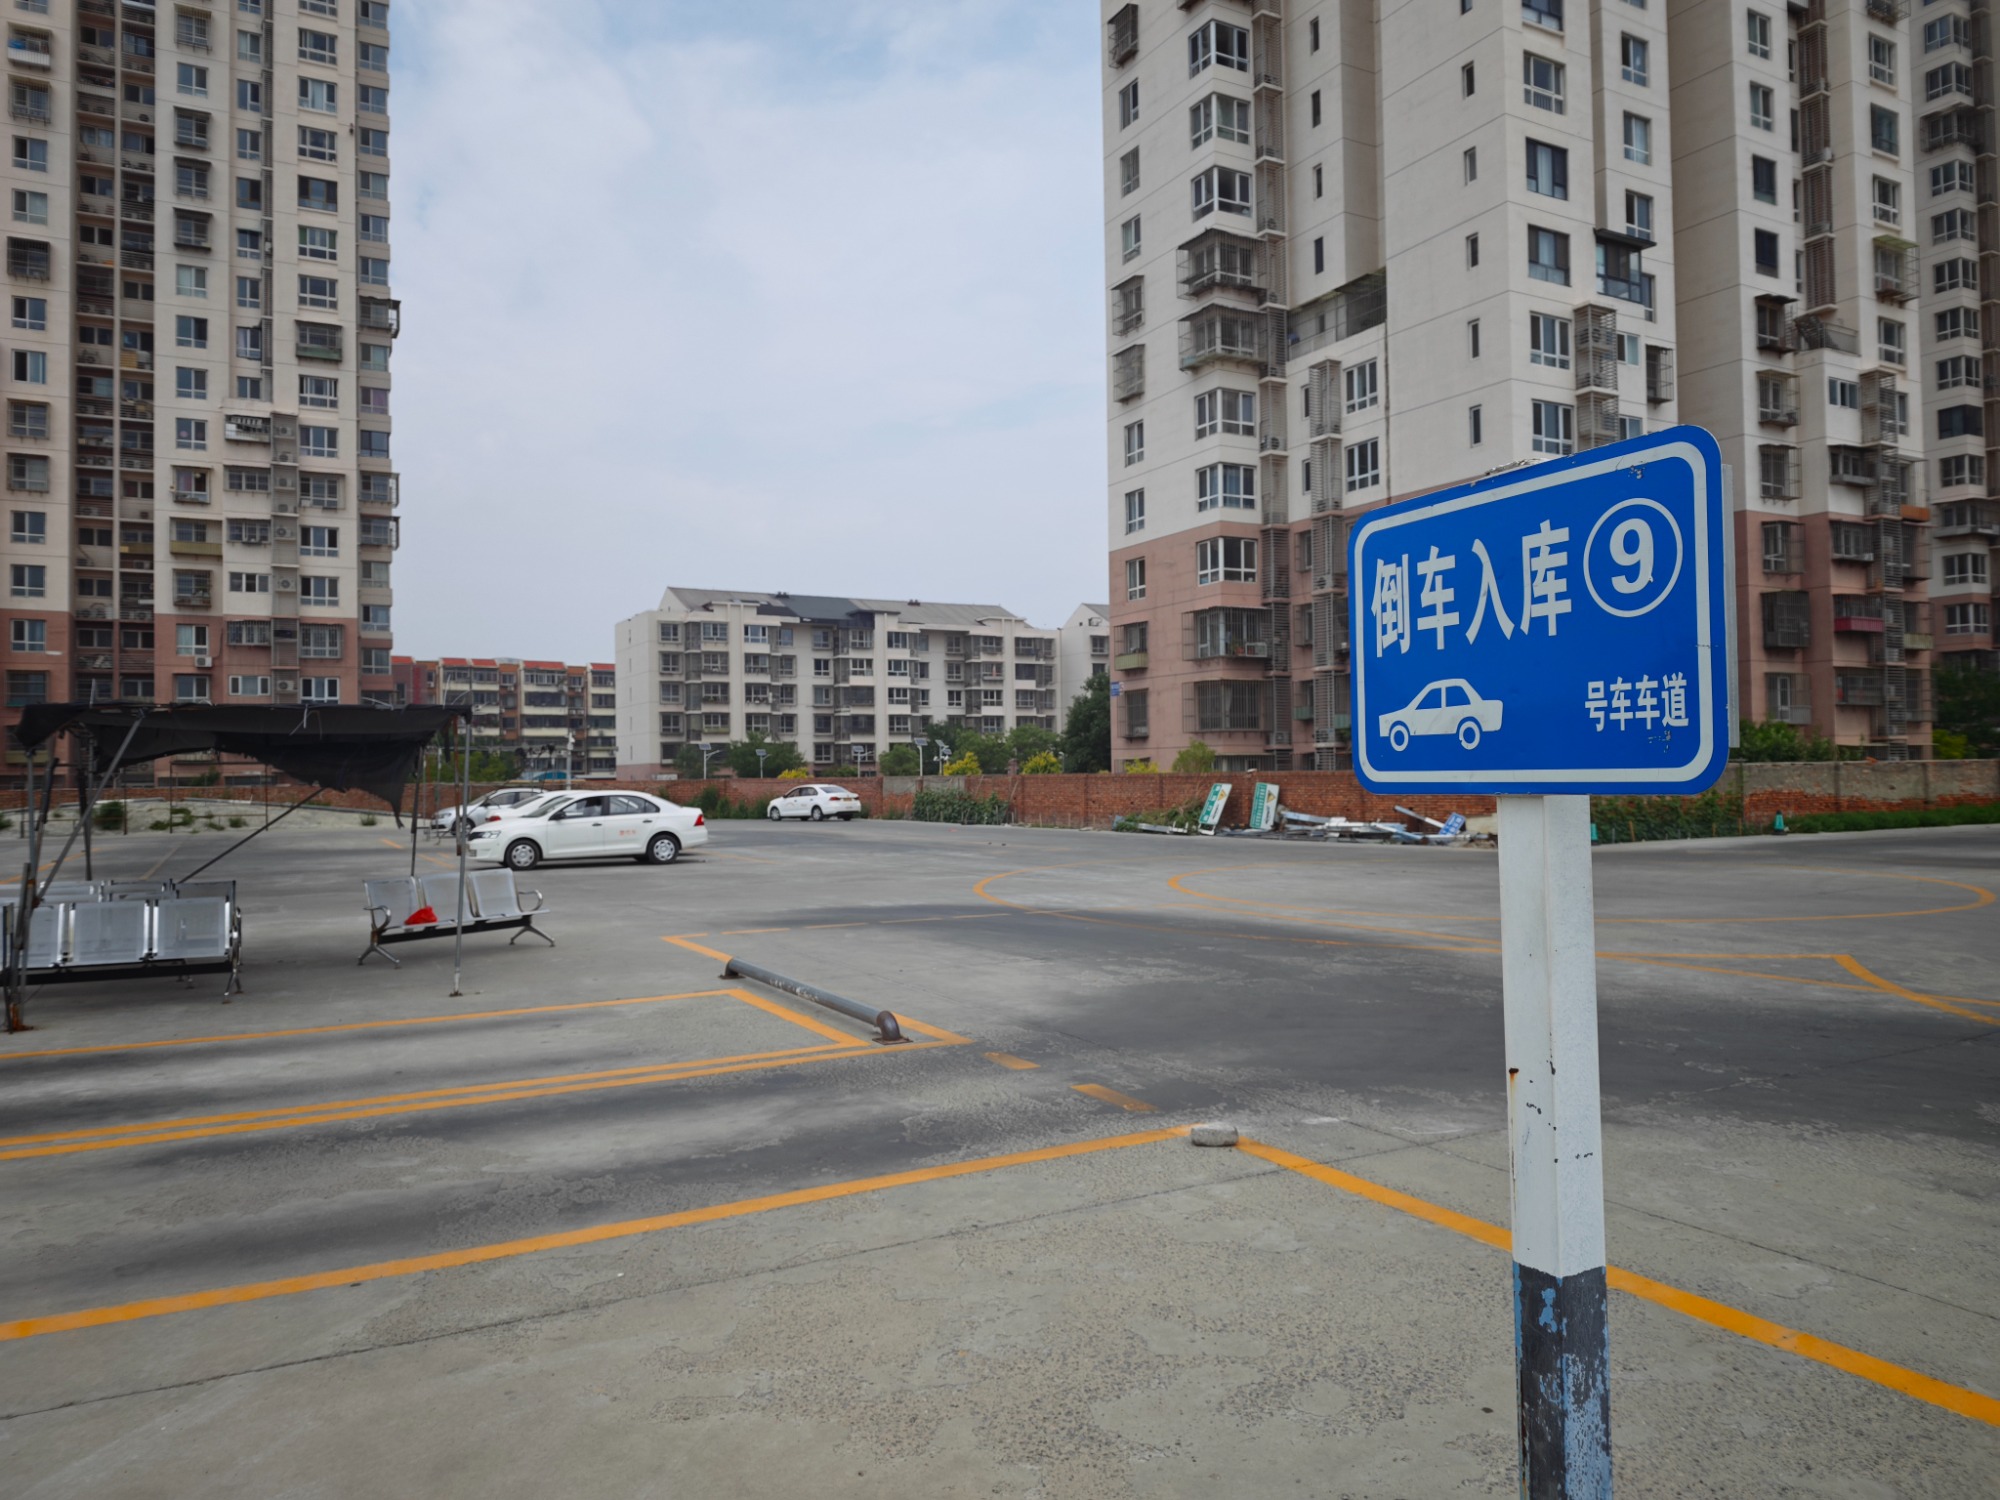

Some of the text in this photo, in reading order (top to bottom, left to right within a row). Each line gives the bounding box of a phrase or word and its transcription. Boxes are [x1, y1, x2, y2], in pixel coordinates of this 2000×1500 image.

[1371, 519, 1571, 657] 倒车入库
[1585, 672, 1689, 731] 号车车道
